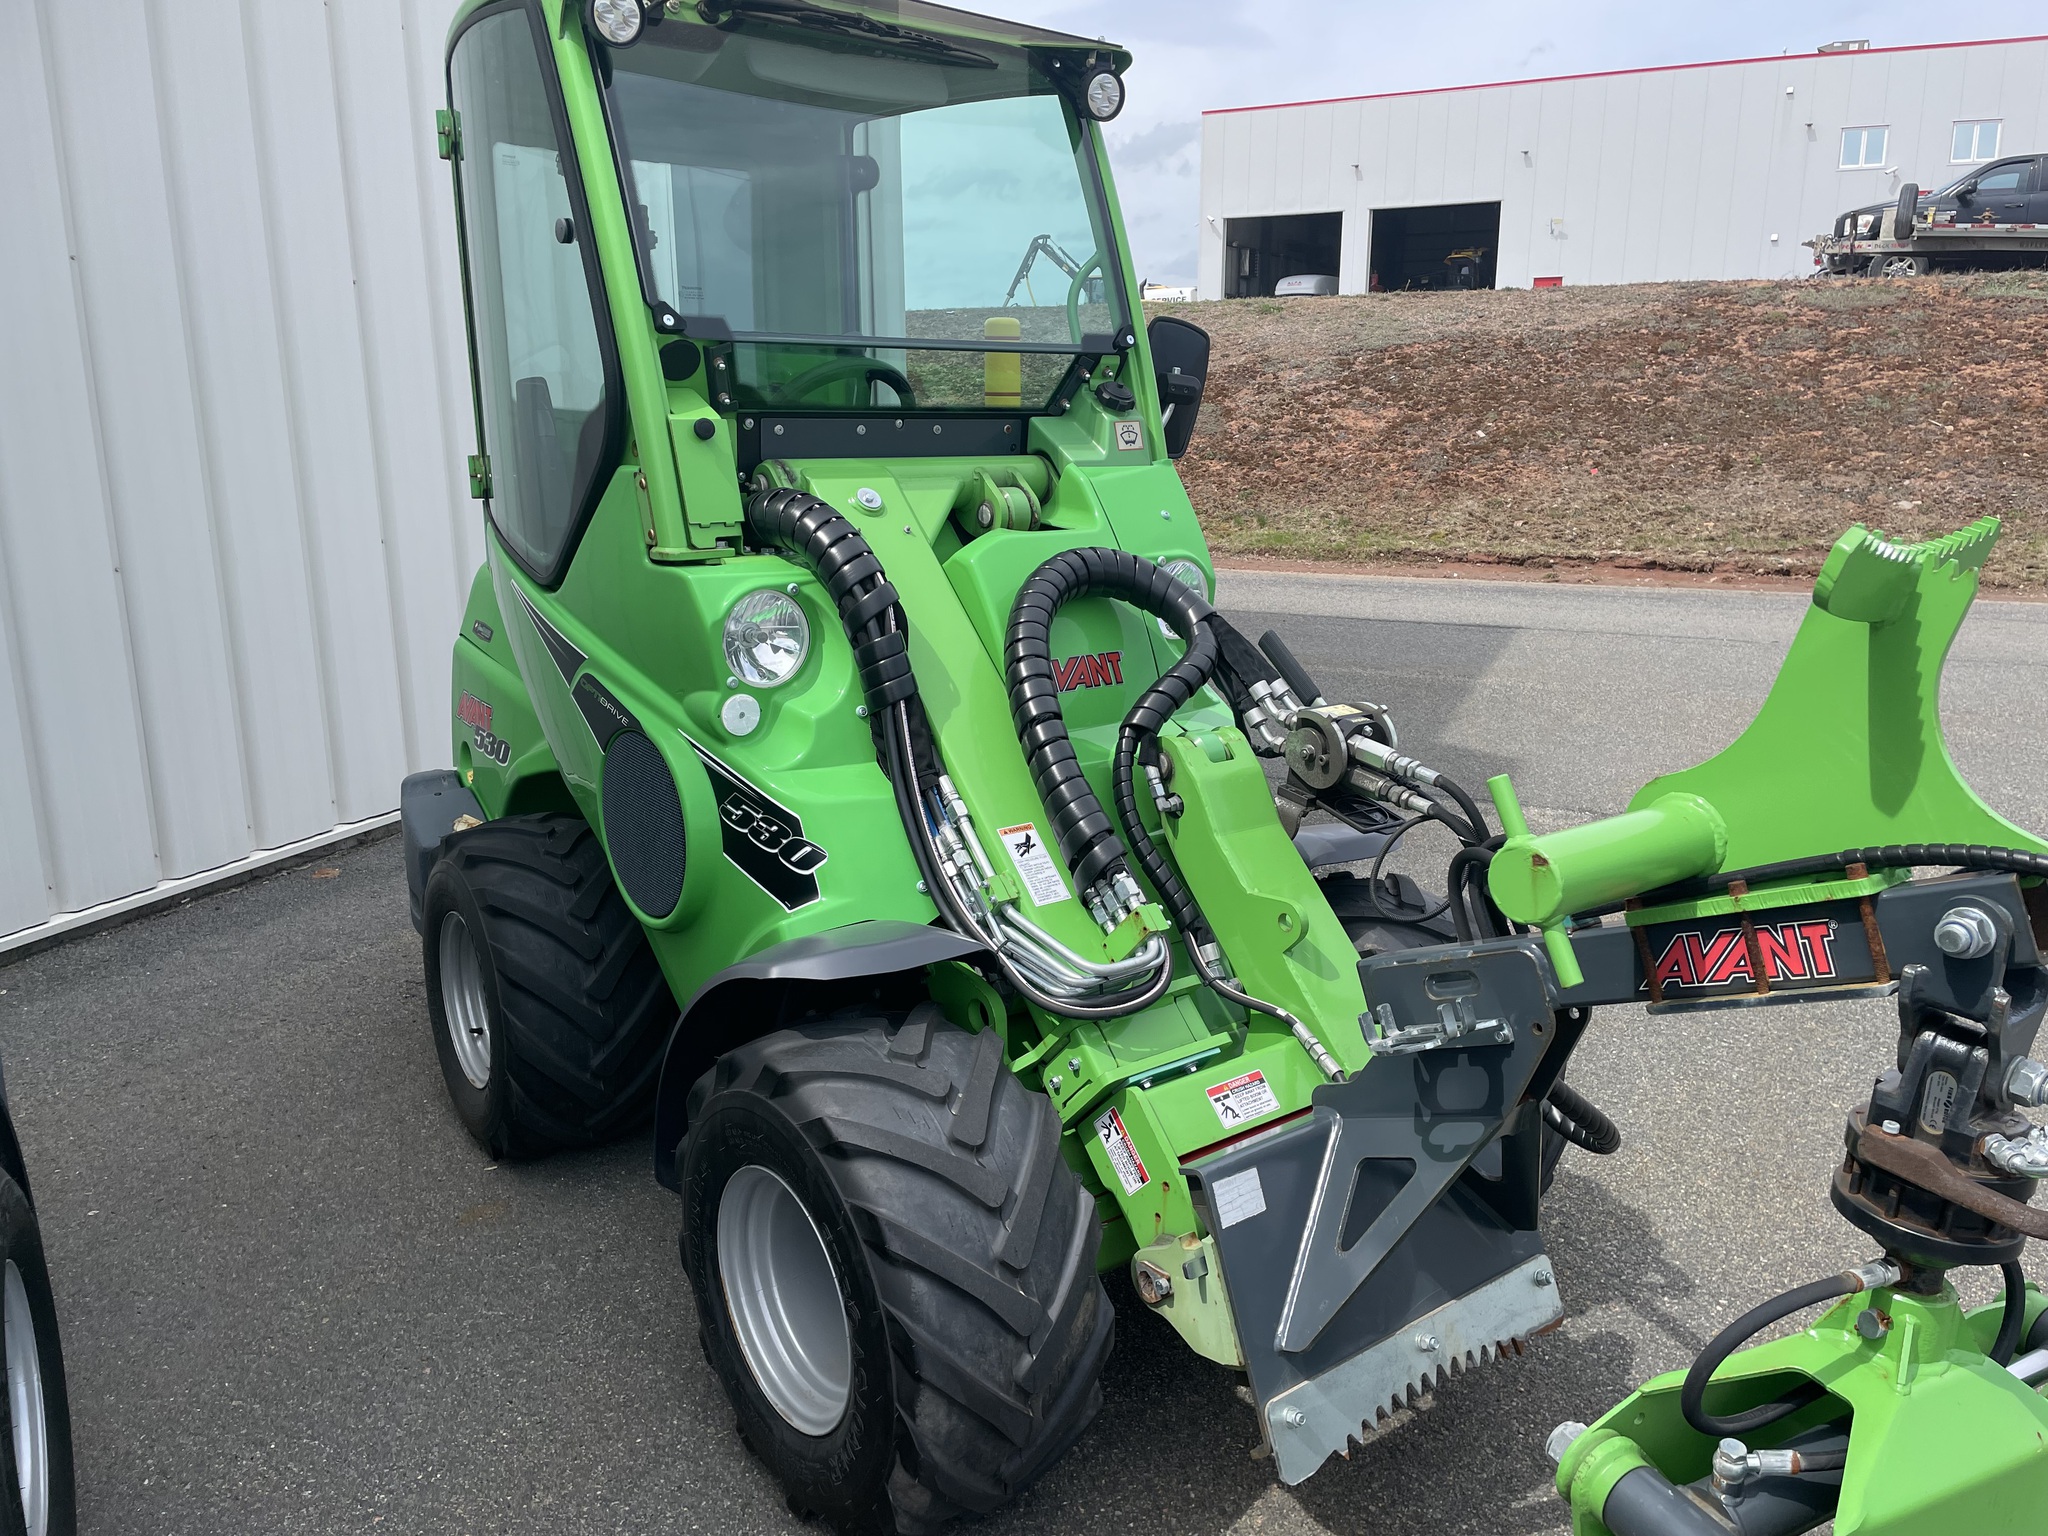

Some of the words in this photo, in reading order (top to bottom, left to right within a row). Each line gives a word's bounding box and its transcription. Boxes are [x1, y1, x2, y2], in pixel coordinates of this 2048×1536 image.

[1051, 650, 1123, 692] VANT
[456, 690, 493, 731] AVANT
[474, 725, 511, 766] 530
[719, 792, 828, 875] 530
[1008, 823, 1033, 834] WARNING
[1227, 1076, 1251, 1089] DANGER
[1124, 1136, 1141, 1165] DANGER
